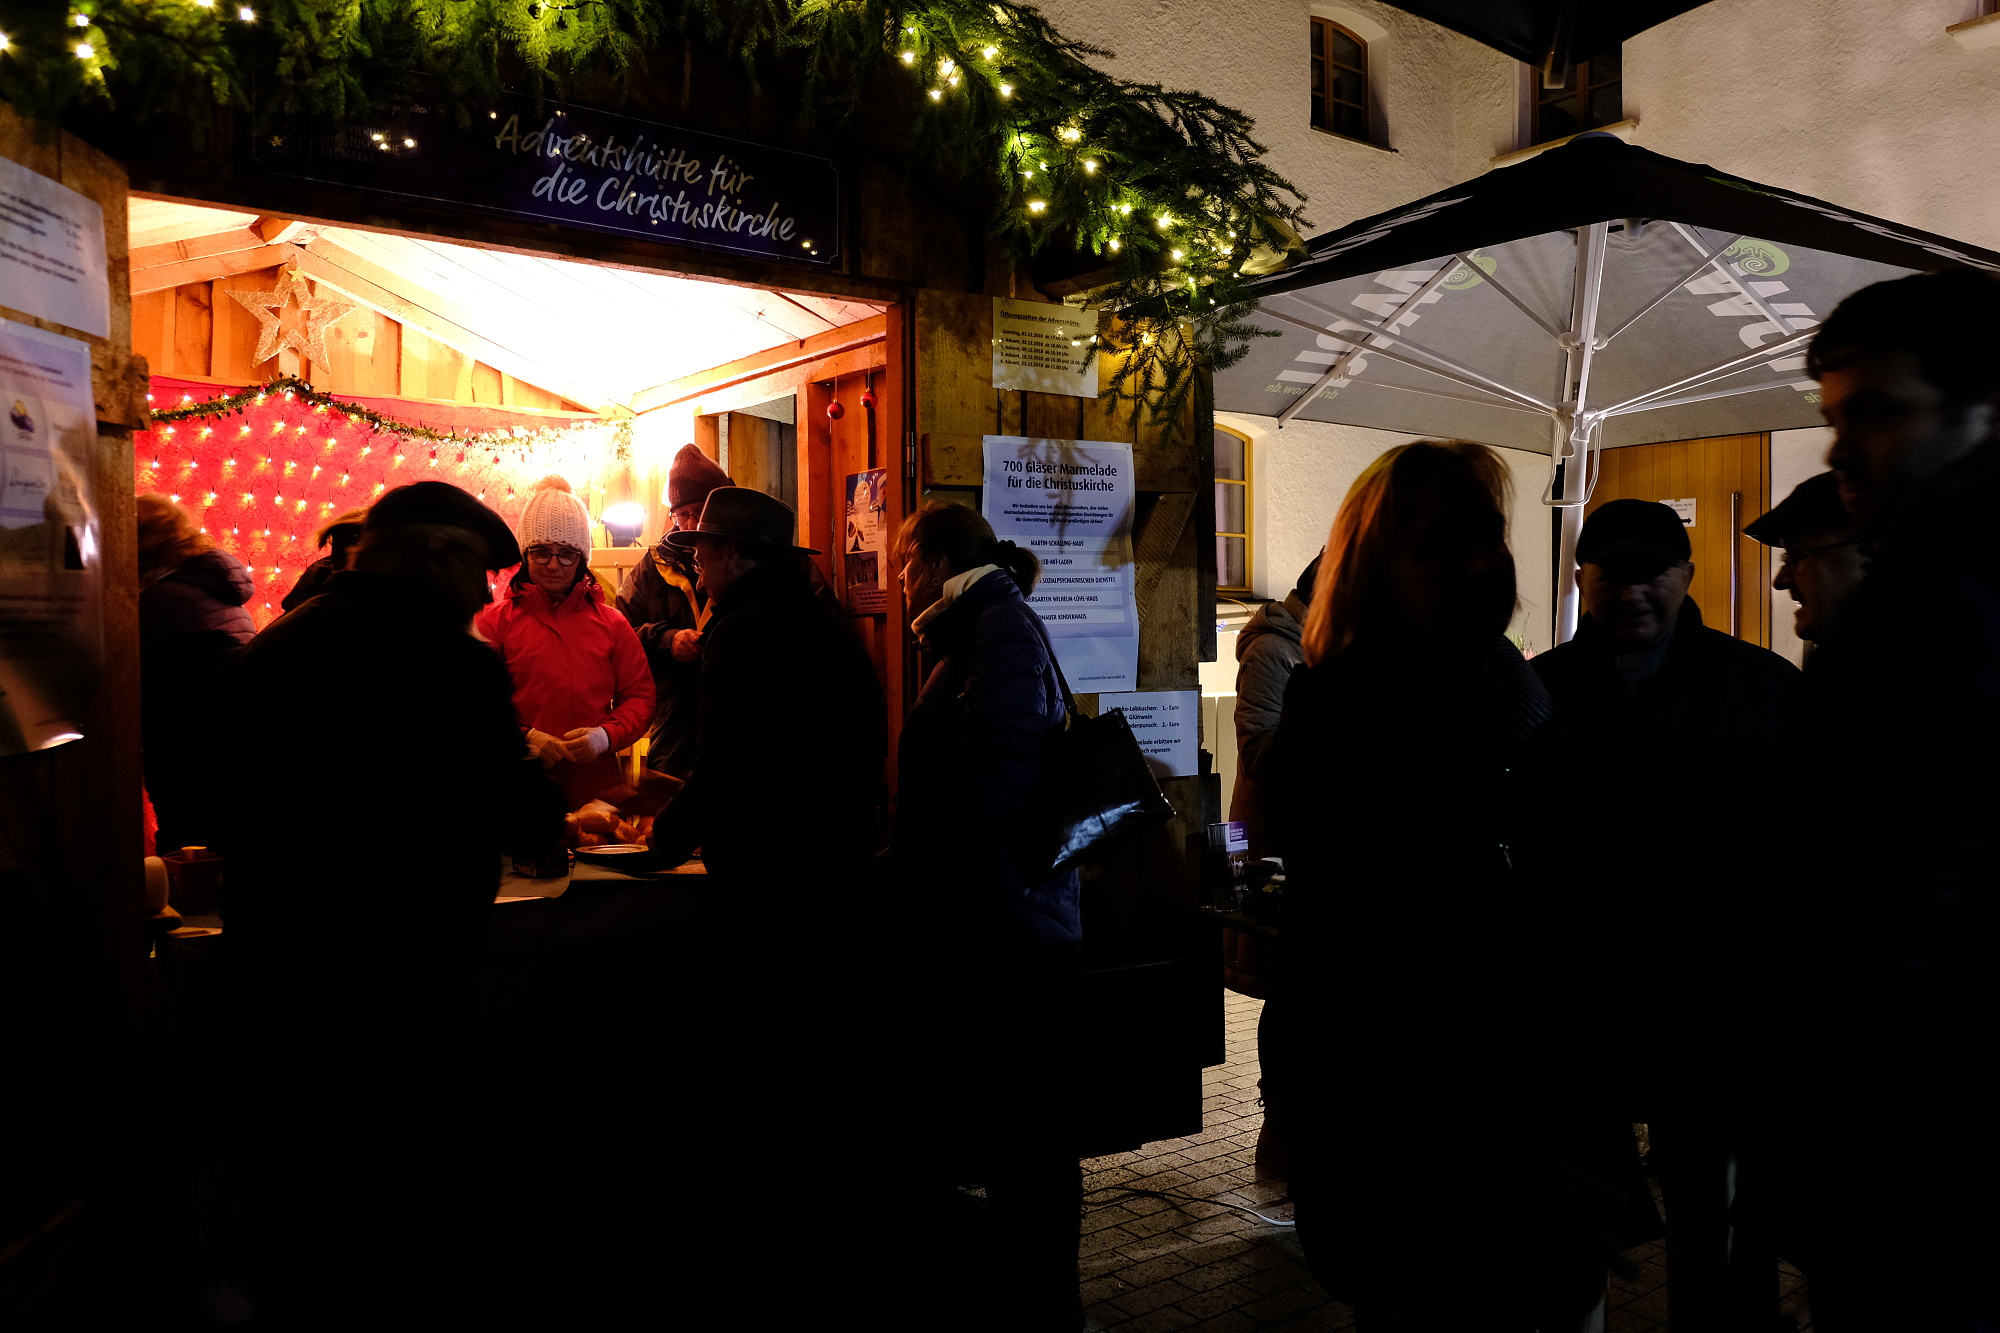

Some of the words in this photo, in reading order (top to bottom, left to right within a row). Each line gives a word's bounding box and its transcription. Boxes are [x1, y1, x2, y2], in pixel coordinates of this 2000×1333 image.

[495, 114, 703, 184] Adventshütte
[707, 154, 754, 196] für
[532, 162, 588, 205] die
[596, 174, 797, 242] Christuskirche
[1000, 310, 1037, 321] Öffnungszeiten
[1003, 460, 1022, 472] 700
[1026, 460, 1056, 474] Gläser
[1060, 463, 1117, 476] Marmelade
[1008, 475, 1022, 488] für
[1026, 476, 1041, 488] die
[1044, 477, 1114, 492] Christuskirche
